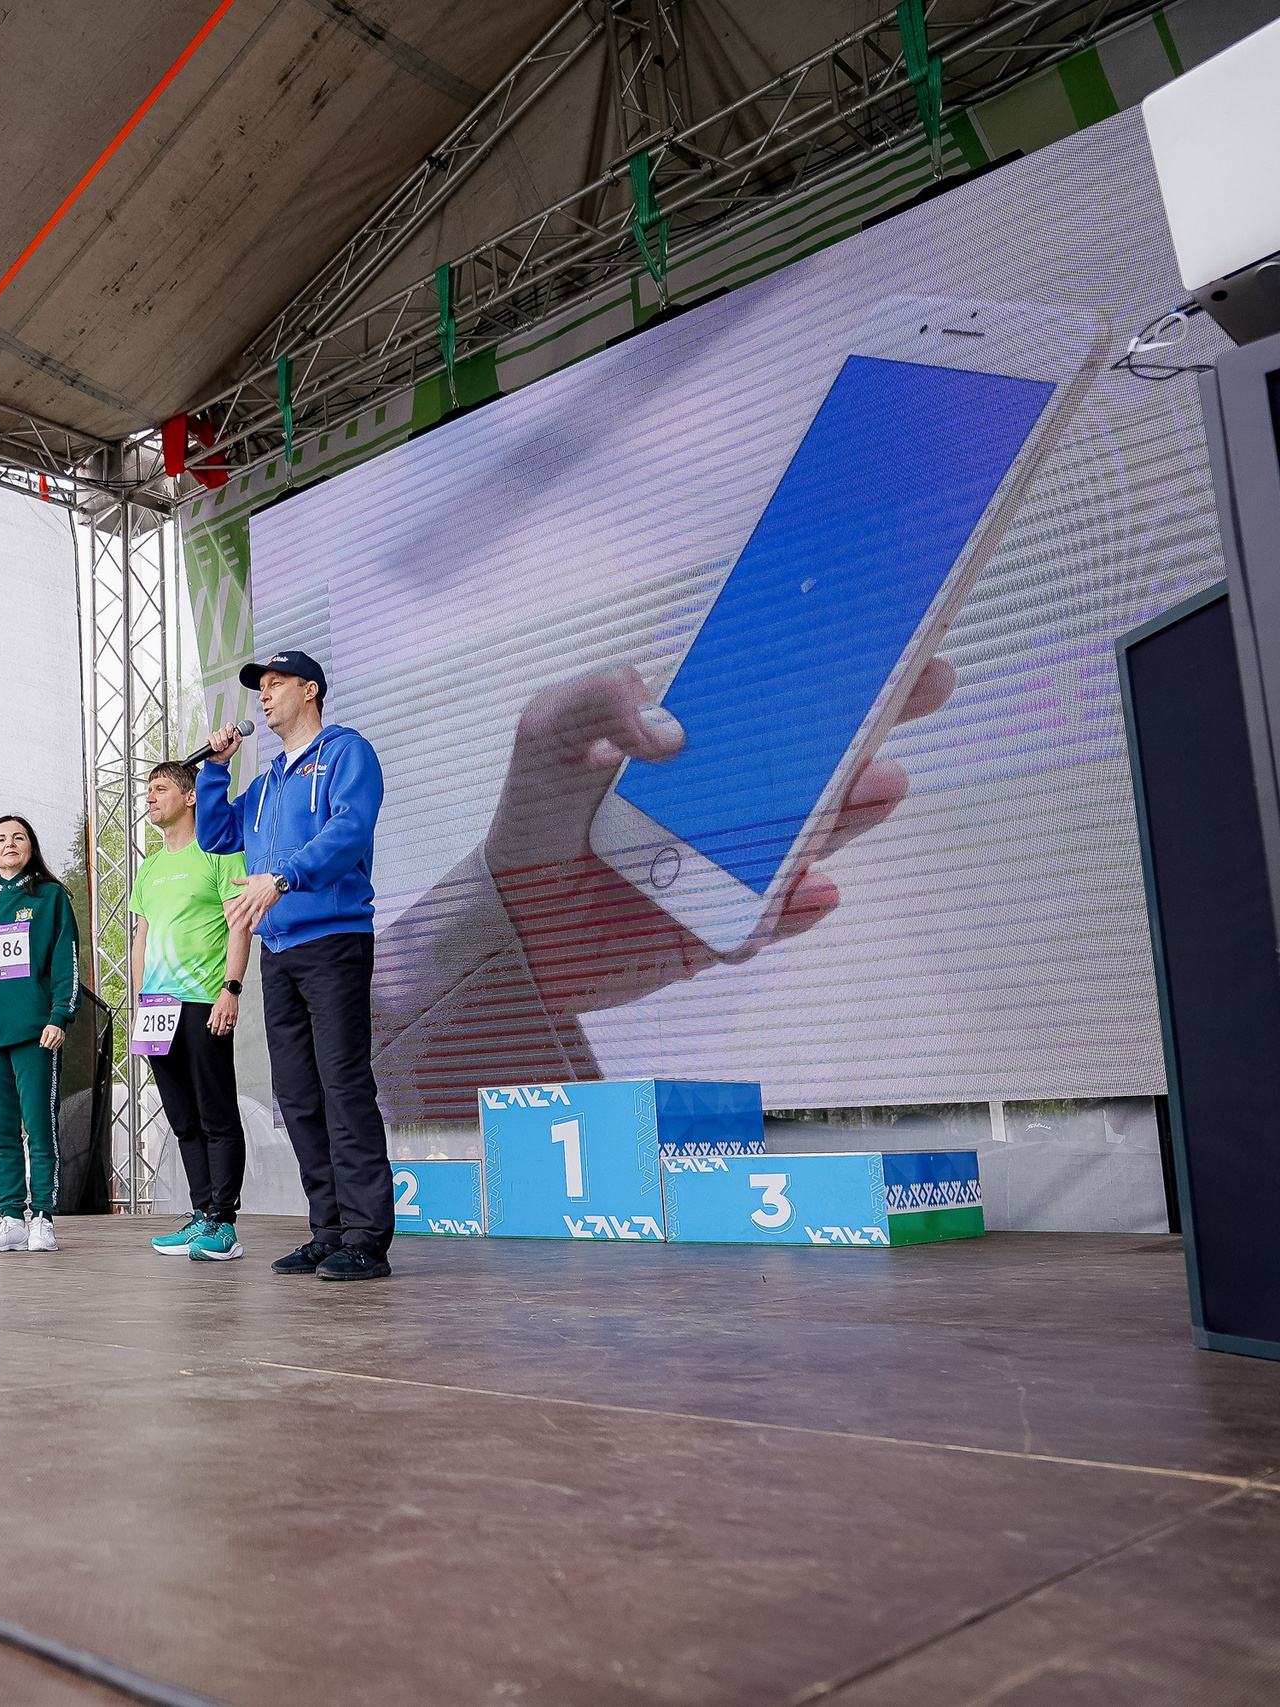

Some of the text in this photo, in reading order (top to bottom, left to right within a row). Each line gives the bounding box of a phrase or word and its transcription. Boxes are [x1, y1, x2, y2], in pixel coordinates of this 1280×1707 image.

[142, 1014, 176, 1033] 2185
[551, 1118, 585, 1198] 1
[392, 1171, 420, 1216] 2
[749, 1173, 793, 1228] 3
